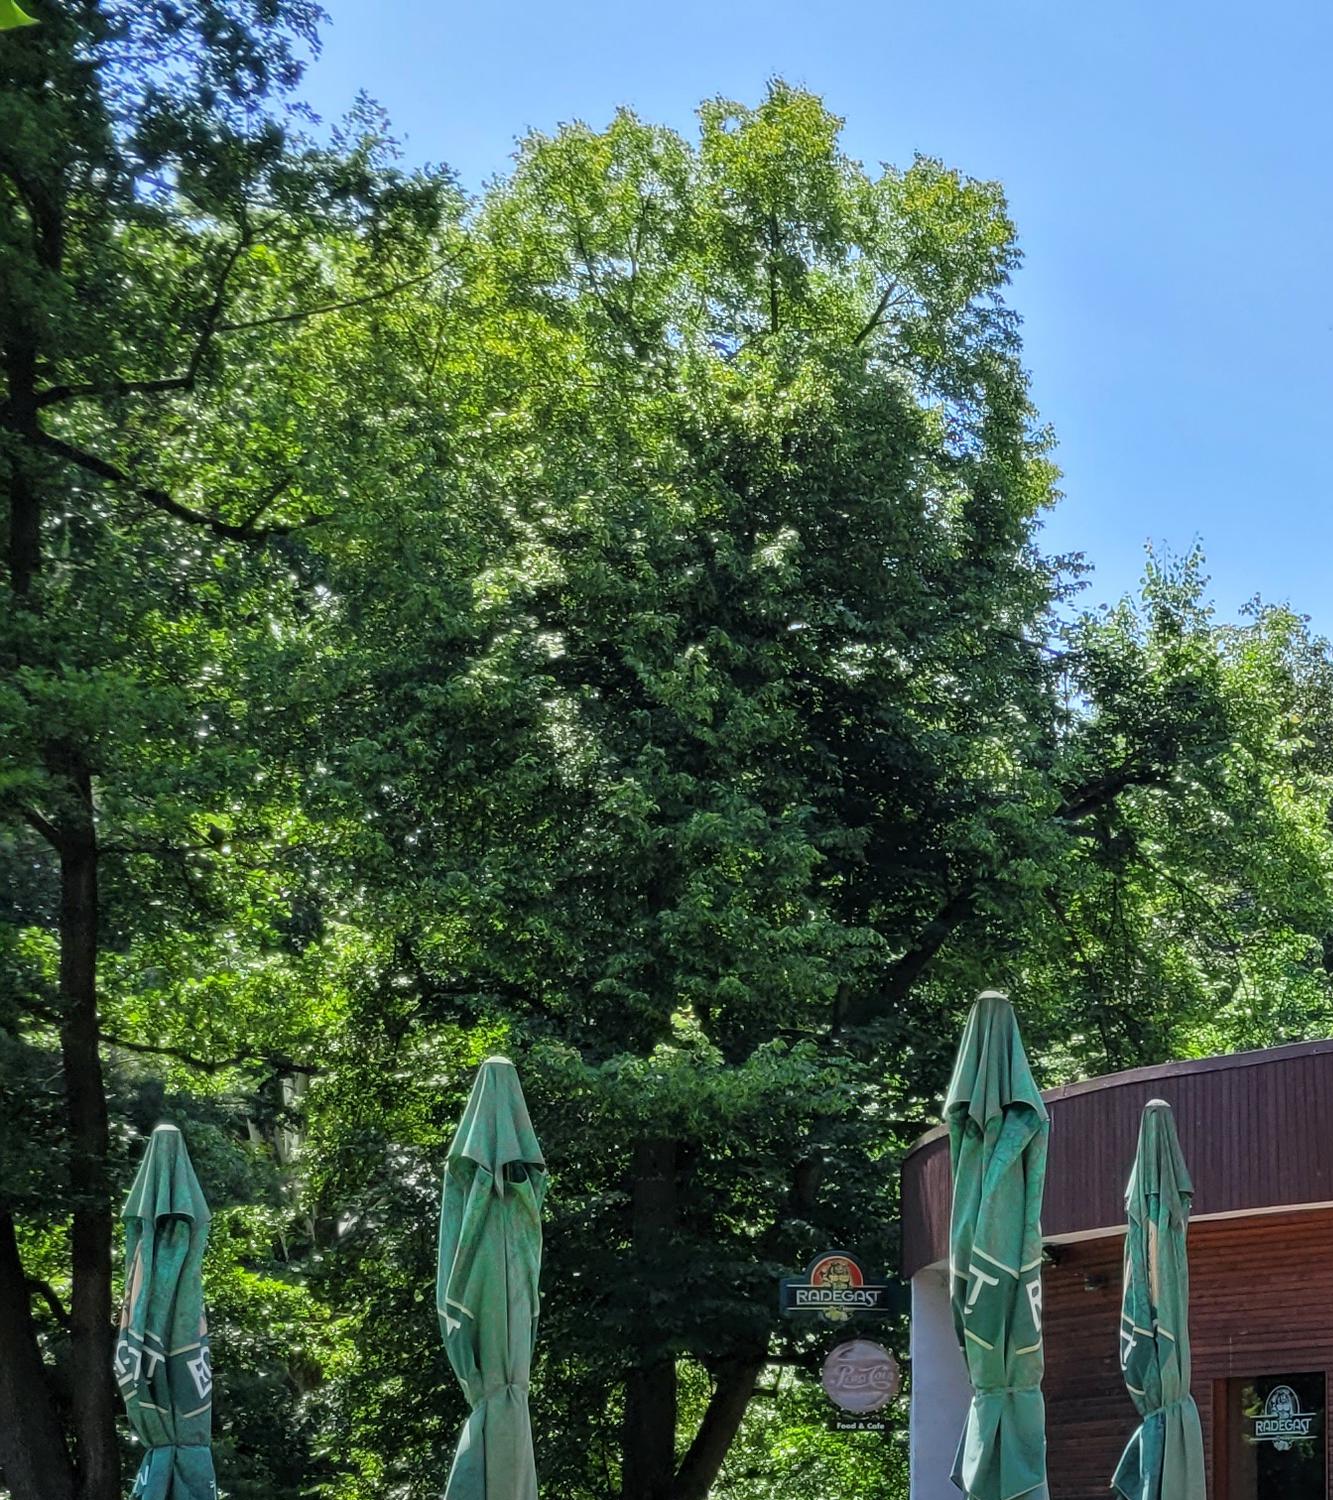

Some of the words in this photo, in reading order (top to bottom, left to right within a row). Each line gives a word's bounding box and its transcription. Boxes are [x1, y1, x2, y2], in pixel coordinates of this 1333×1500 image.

[795, 1289, 882, 1307] RADEGAST
[836, 1422, 857, 1430] Food
[858, 1422, 865, 1430] &
[866, 1422, 885, 1430] Cafe
[1255, 1416, 1313, 1436] RADEGAST
